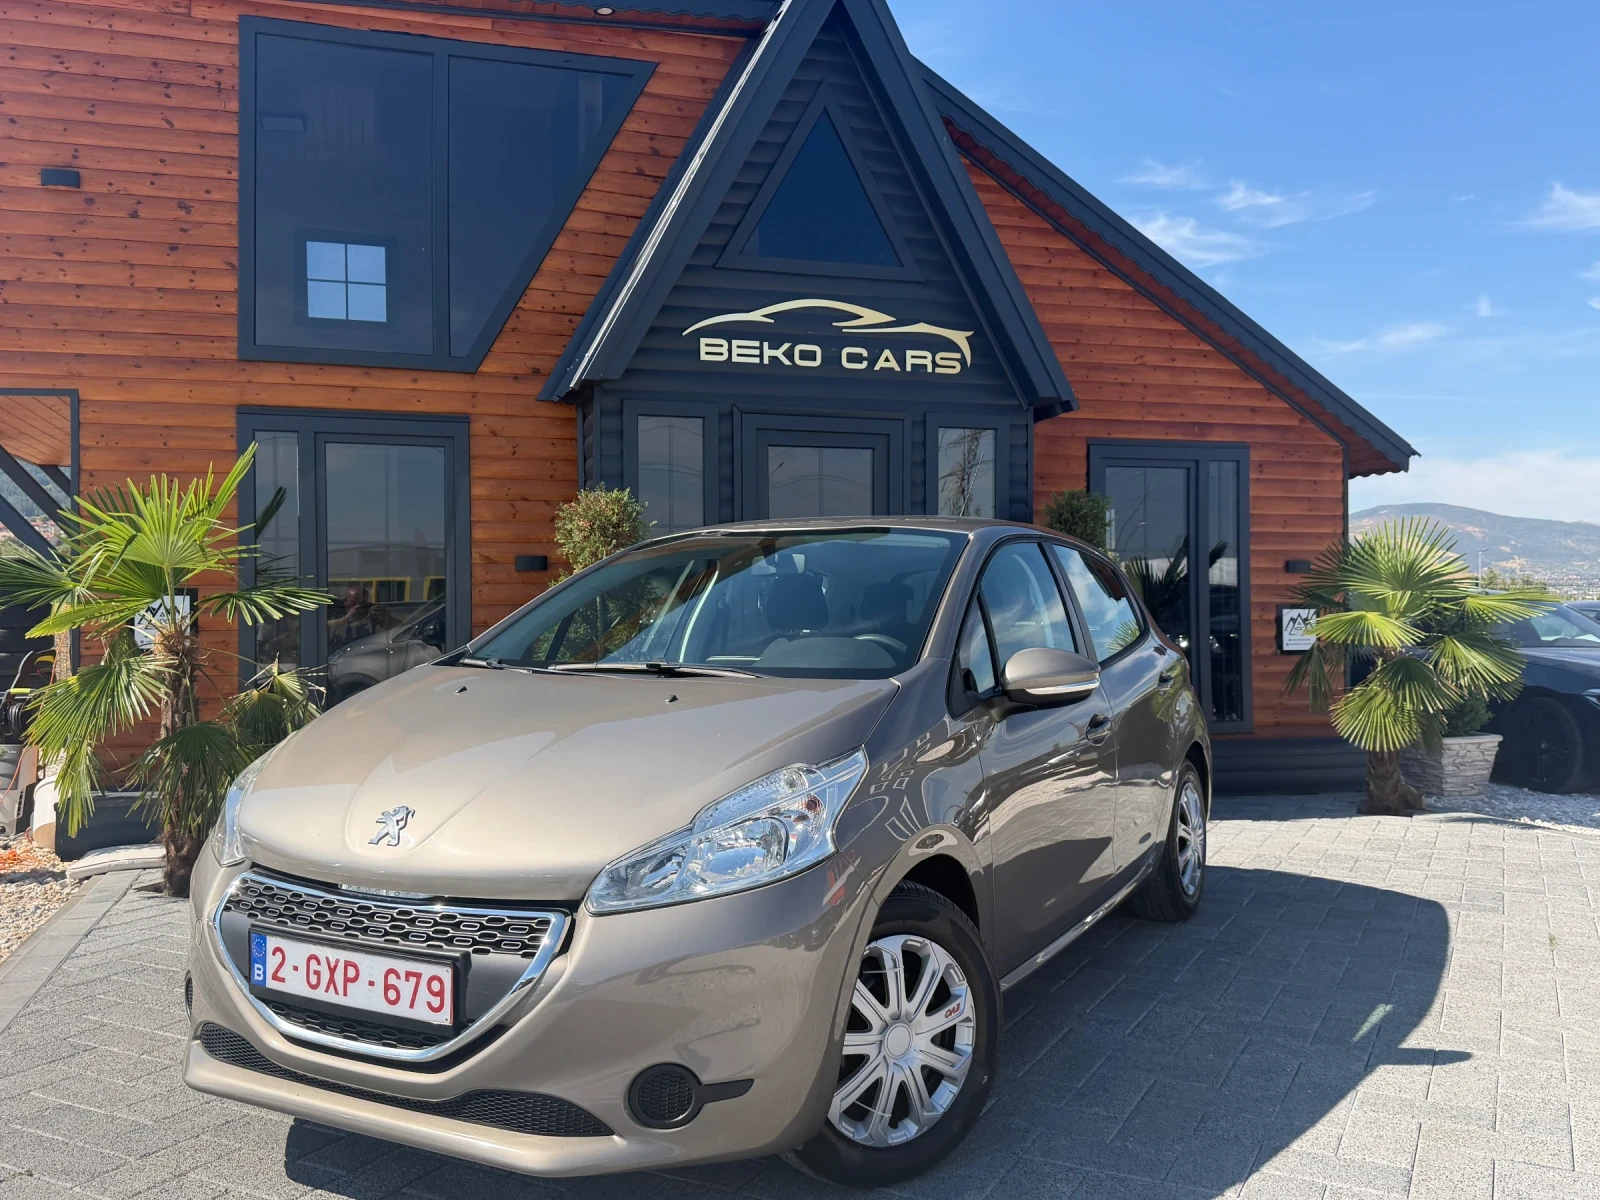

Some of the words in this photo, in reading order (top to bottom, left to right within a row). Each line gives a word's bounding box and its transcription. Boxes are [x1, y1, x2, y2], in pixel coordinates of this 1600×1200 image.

[699, 337, 822, 368] BEKO
[841, 346, 962, 375] CARS
[253, 963, 264, 981] B
[271, 946, 445, 1013] 2-GXP-679
